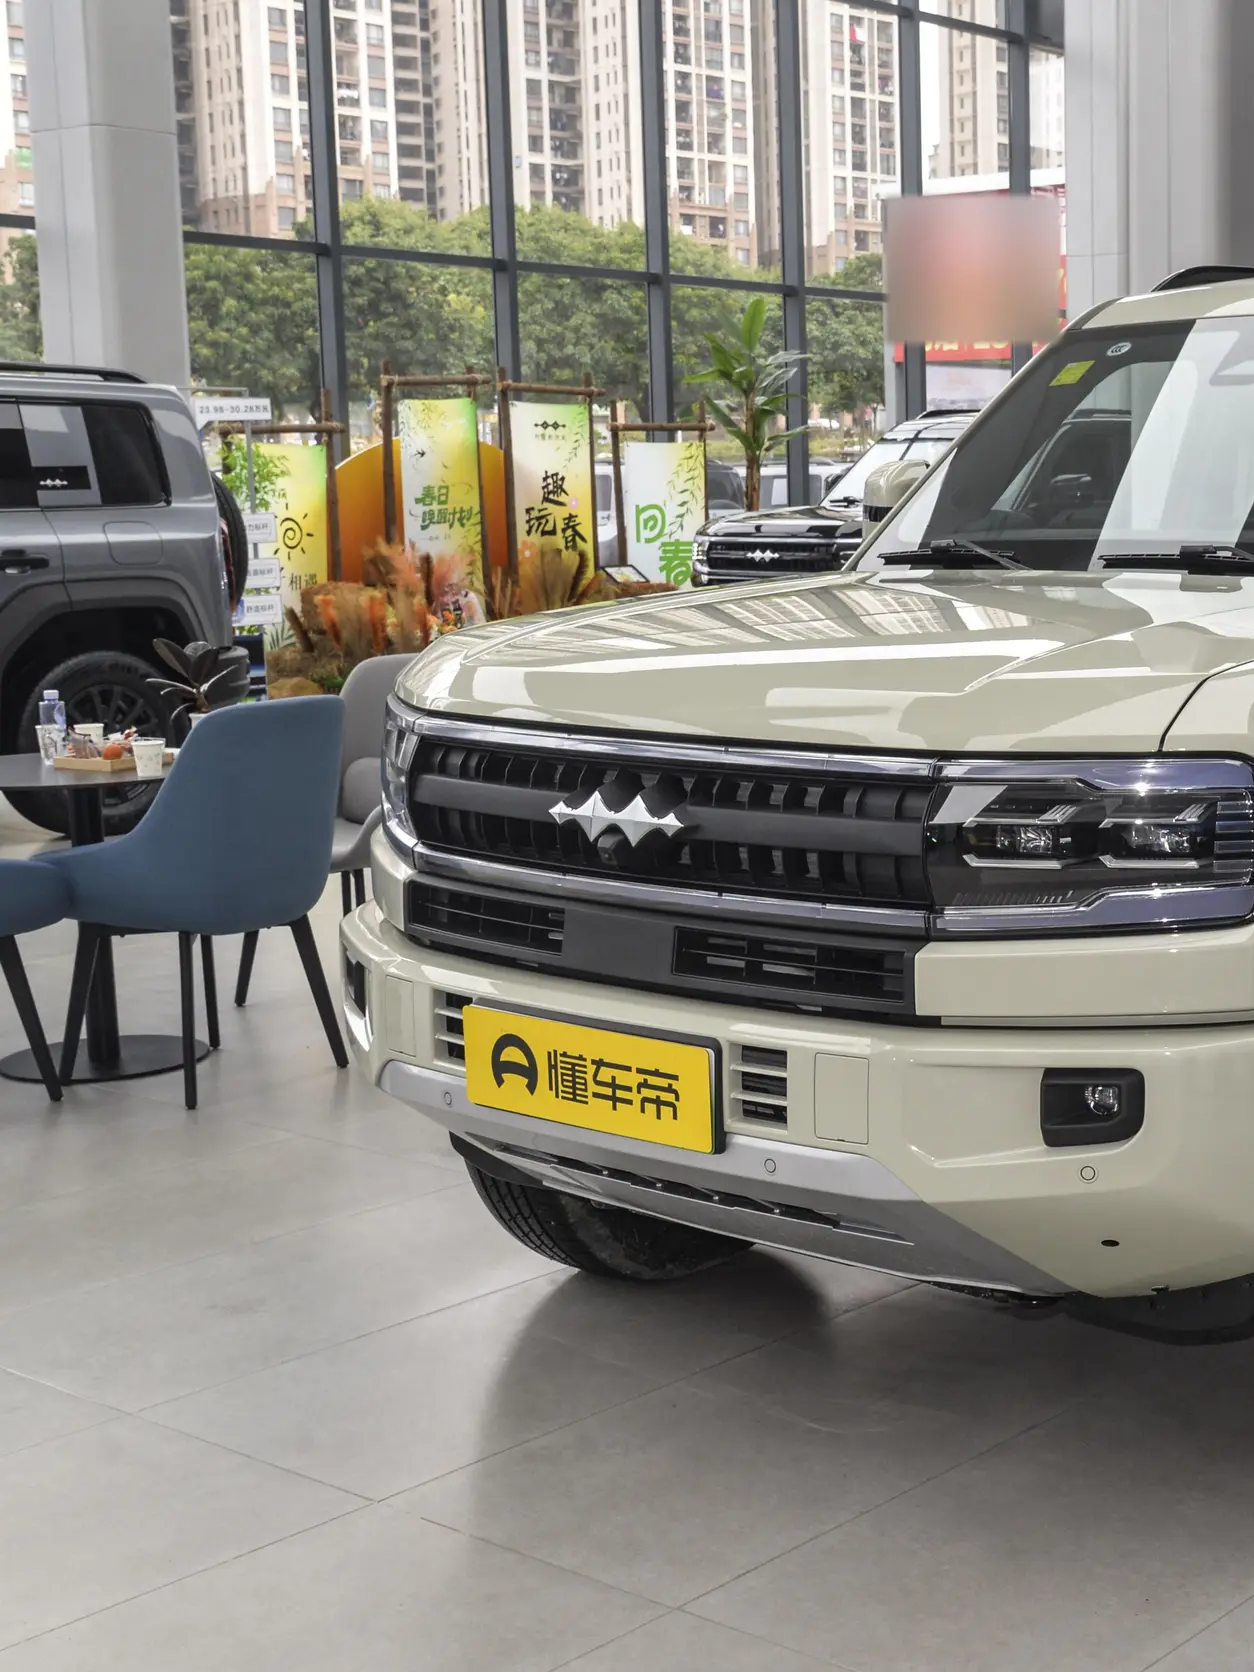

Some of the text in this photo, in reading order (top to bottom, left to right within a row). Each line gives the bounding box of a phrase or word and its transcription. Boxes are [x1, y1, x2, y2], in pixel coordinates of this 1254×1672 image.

[414, 485, 450, 507] 春日
[541, 469, 569, 506] 趣
[420, 506, 473, 532] 唤醒计划
[283, 569, 319, 592] 相遇
[547, 1049, 680, 1120] 懂车帝
